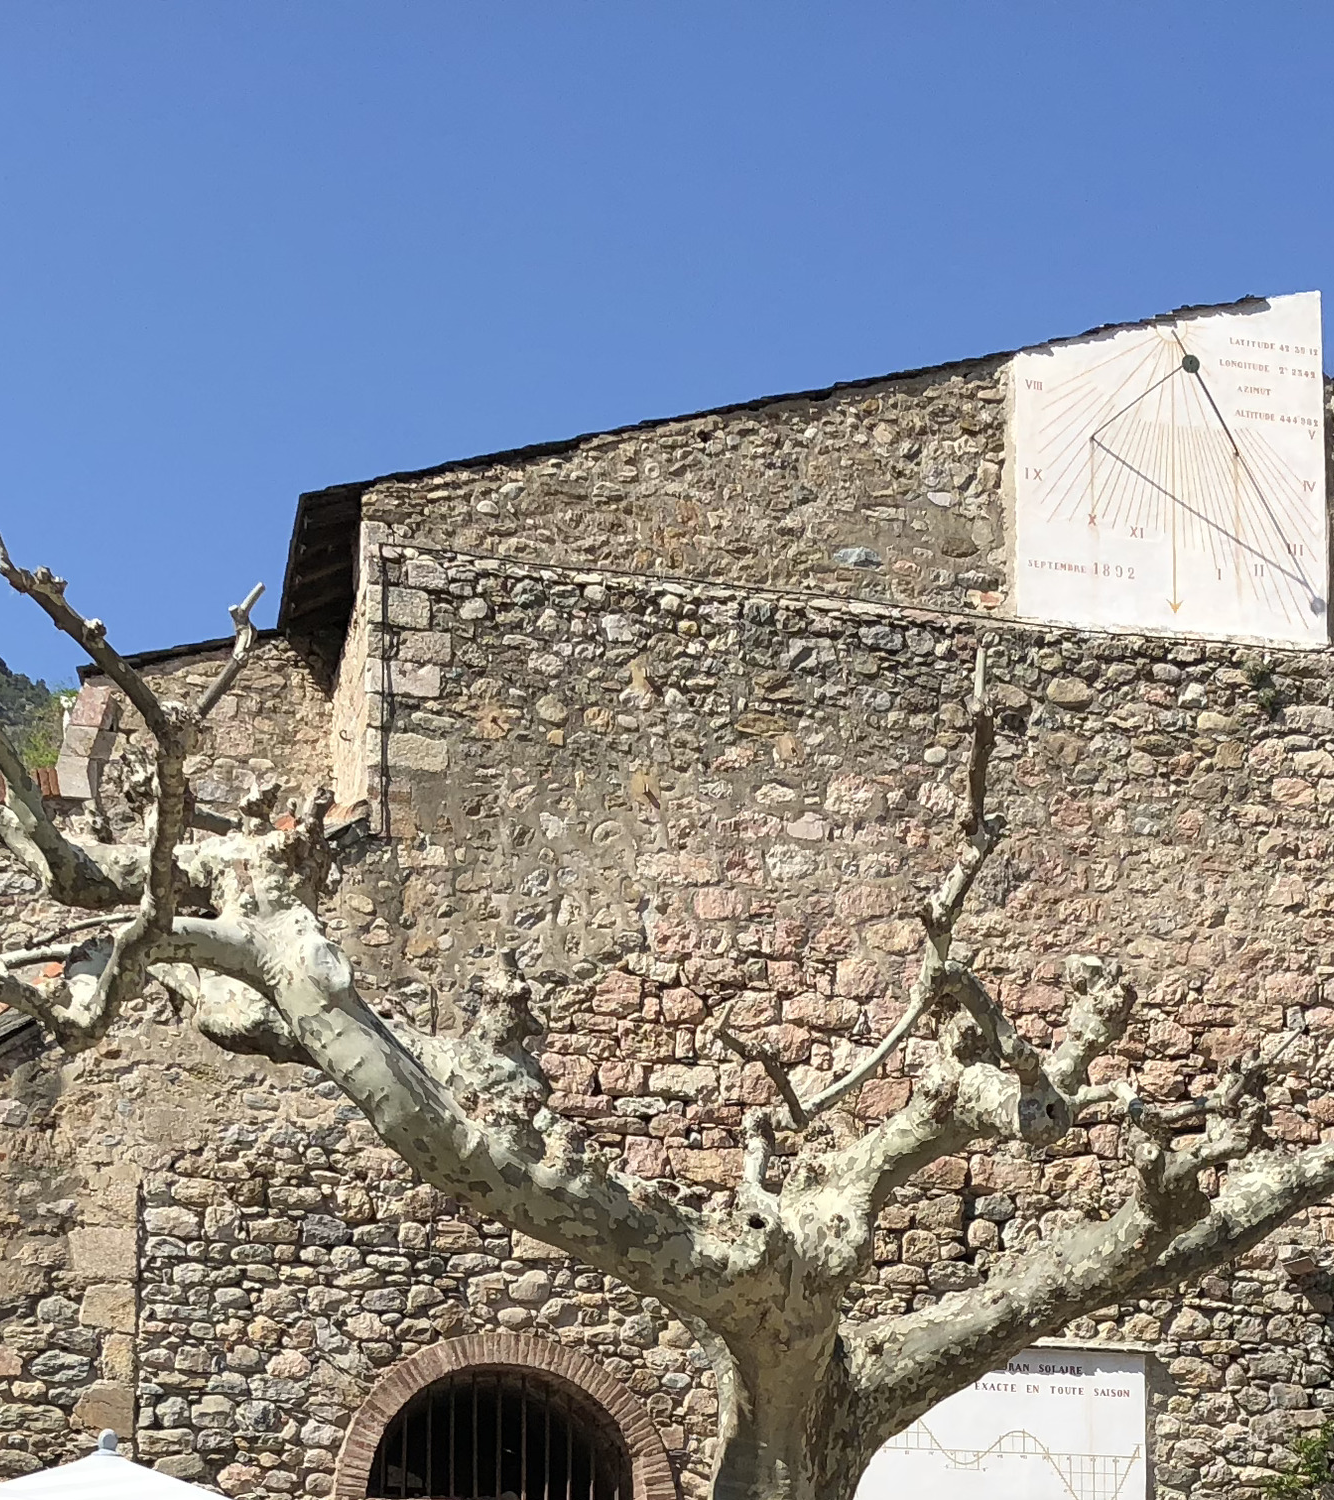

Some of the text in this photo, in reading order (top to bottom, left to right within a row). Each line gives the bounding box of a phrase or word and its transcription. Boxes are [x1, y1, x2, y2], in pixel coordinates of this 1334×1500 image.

[1229, 336, 1275, 350] LATITUDE
[1218, 358, 1270, 373] LONGITUDE
[1237, 385, 1271, 396] AZIMUT
[1234, 408, 1275, 422] ALTITUDE
[1027, 558, 1136, 580] SEPTEMBRE 1892
[1038, 1363, 1083, 1375] SOLAIRE
[974, 1381, 1131, 1398] EXACTE EN TOUTE SAISON
